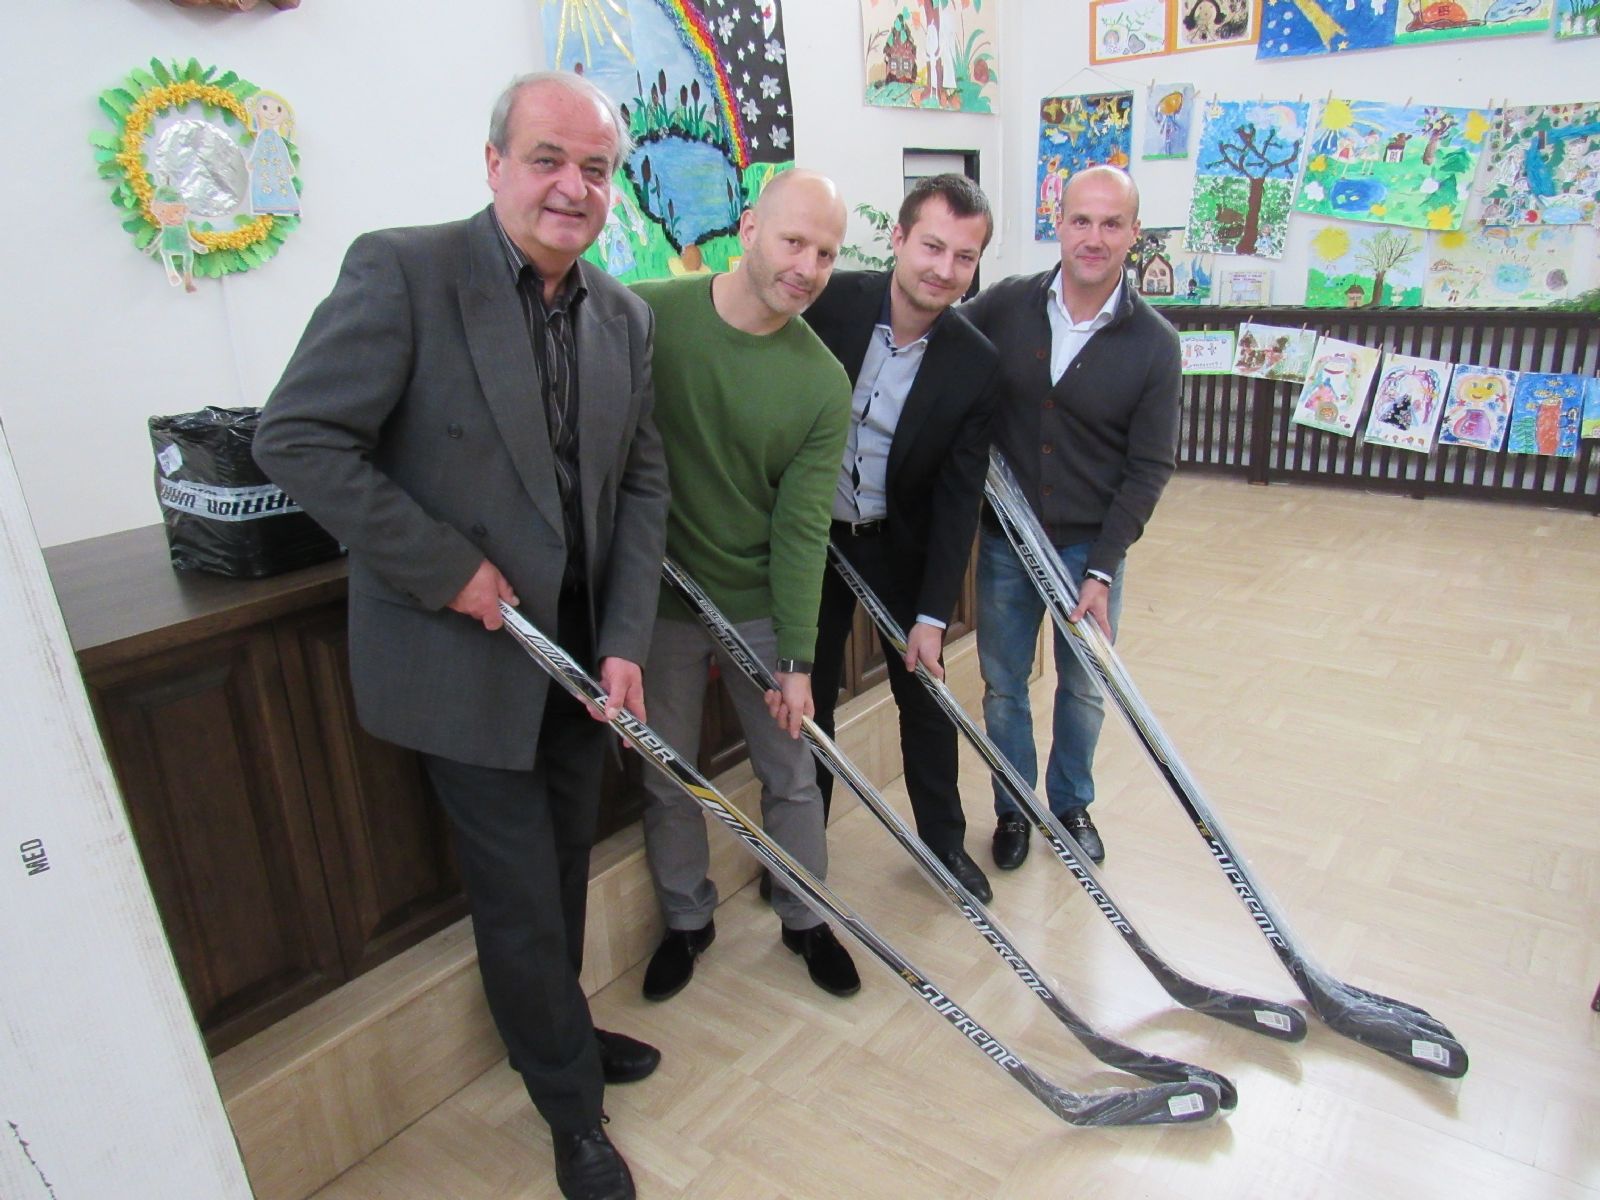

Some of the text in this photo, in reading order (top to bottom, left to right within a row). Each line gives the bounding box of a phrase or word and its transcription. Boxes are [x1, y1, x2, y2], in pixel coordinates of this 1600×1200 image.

[207, 490, 297, 516] RRIOR
[20, 839, 50, 876] MED
[1050, 839, 1133, 935] SUPREME
[1210, 840, 1290, 949] SUPREME
[961, 905, 1053, 1000] SUPREME
[912, 984, 1022, 1072] SUPREME
